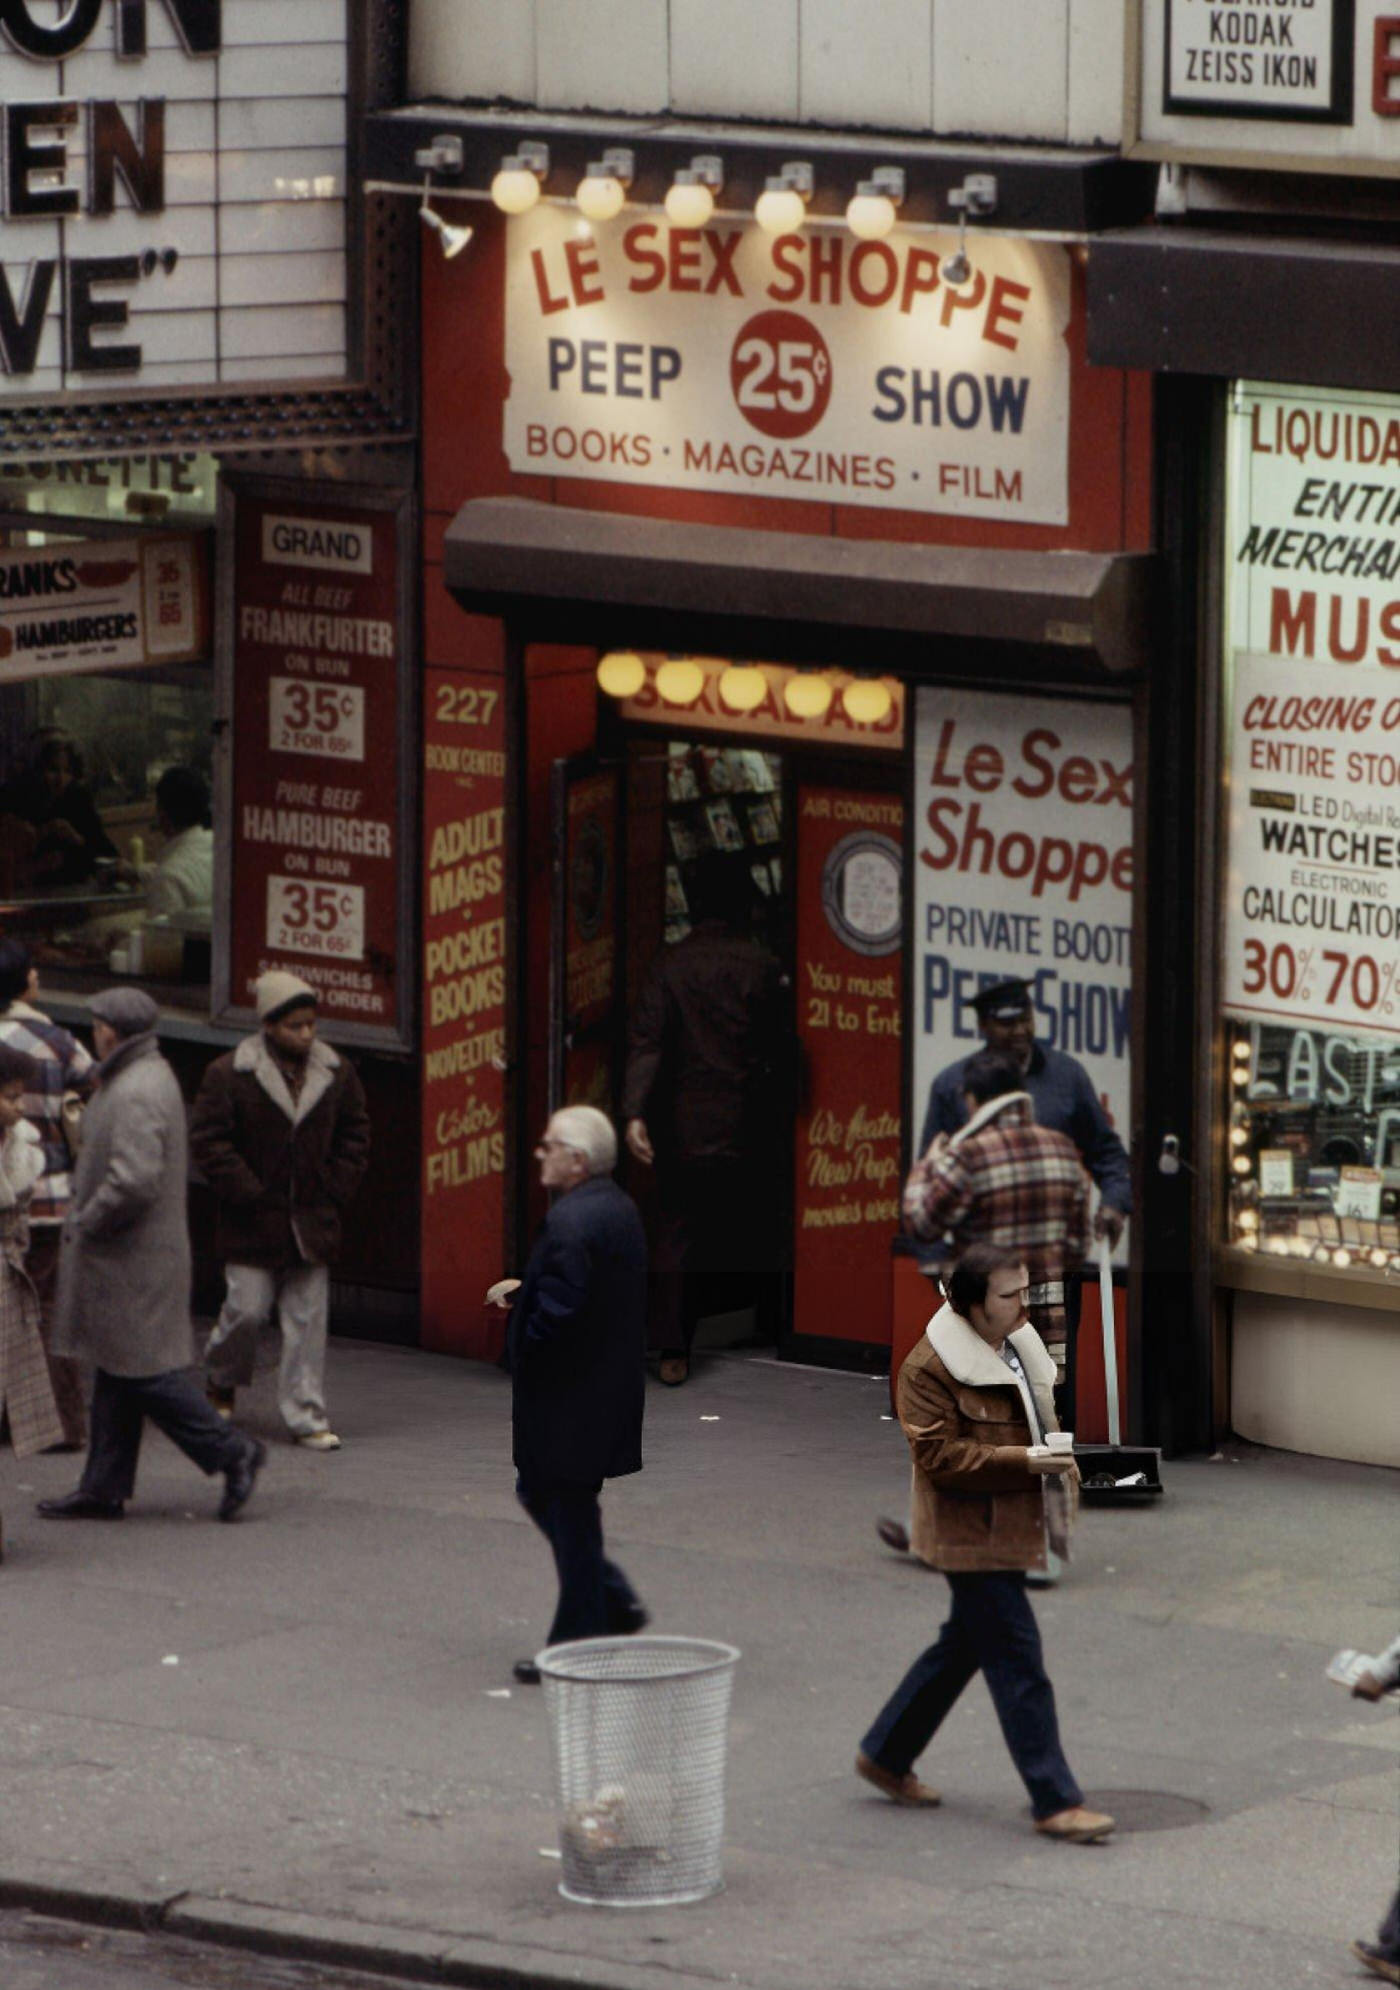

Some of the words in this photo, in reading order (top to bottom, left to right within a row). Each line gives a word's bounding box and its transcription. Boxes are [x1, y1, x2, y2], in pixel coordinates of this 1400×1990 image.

[1210, 11, 1294, 47] KODAK
[1186, 49, 1253, 84] ZEISS
[1263, 53, 1316, 89] IKON
[4, 96, 166, 219] EN
[531, 236, 605, 315] LE
[624, 224, 744, 297] SEX
[767, 234, 1032, 352] SHOPPE
[548, 338, 681, 400] PEEP
[735, 339, 828, 412] 25¢
[871, 366, 1030, 434] SHOW
[526, 425, 652, 466] BOOKS
[683, 439, 897, 490] MAGAZINES
[938, 464, 1023, 502] FILM
[272, 524, 362, 562] GRAND
[1237, 525, 1400, 581] MERCHA
[15, 612, 137, 650] HAMBURGERS
[241, 605, 394, 658] FRANKFURTER
[1269, 587, 1400, 671] MUS
[284, 652, 310, 672] ON
[283, 683, 353, 733] 35¢
[435, 685, 498, 725] 227
[1242, 694, 1376, 733] CLOSING
[281, 730, 291, 746] 2
[293, 732, 325, 750] FOR
[930, 718, 1004, 793] Le
[1011, 728, 1133, 808] Sex
[1250, 739, 1336, 779] ENTIRE
[276, 781, 319, 806] PURE
[321, 785, 363, 812] BEEF
[1299, 793, 1338, 819] LED
[243, 805, 391, 858] HAMBURGER
[429, 807, 505, 871] ADULT
[920, 797, 1133, 901] Shoppe
[284, 853, 310, 872] ON
[315, 856, 350, 878] BUN
[430, 855, 502, 916] MAGS
[1291, 869, 1388, 899] ELECTRONIC
[281, 883, 353, 933] 35¢
[1242, 886, 1400, 940] CALCULATO
[278, 929, 288, 945] 2
[292, 930, 323, 949] FOR
[426, 917, 505, 982] POCKET
[926, 903, 1041, 955] PRIVATE
[1053, 918, 1132, 967] BOOT
[327, 990, 383, 1013] ORDER
[430, 965, 505, 1027] BOOKS
[806, 962, 841, 992] You
[848, 975, 894, 999] must
[808, 998, 829, 1028] 21
[836, 1003, 859, 1030] to
[809, 1109, 842, 1145] We
[427, 1131, 505, 1195] FILMS
